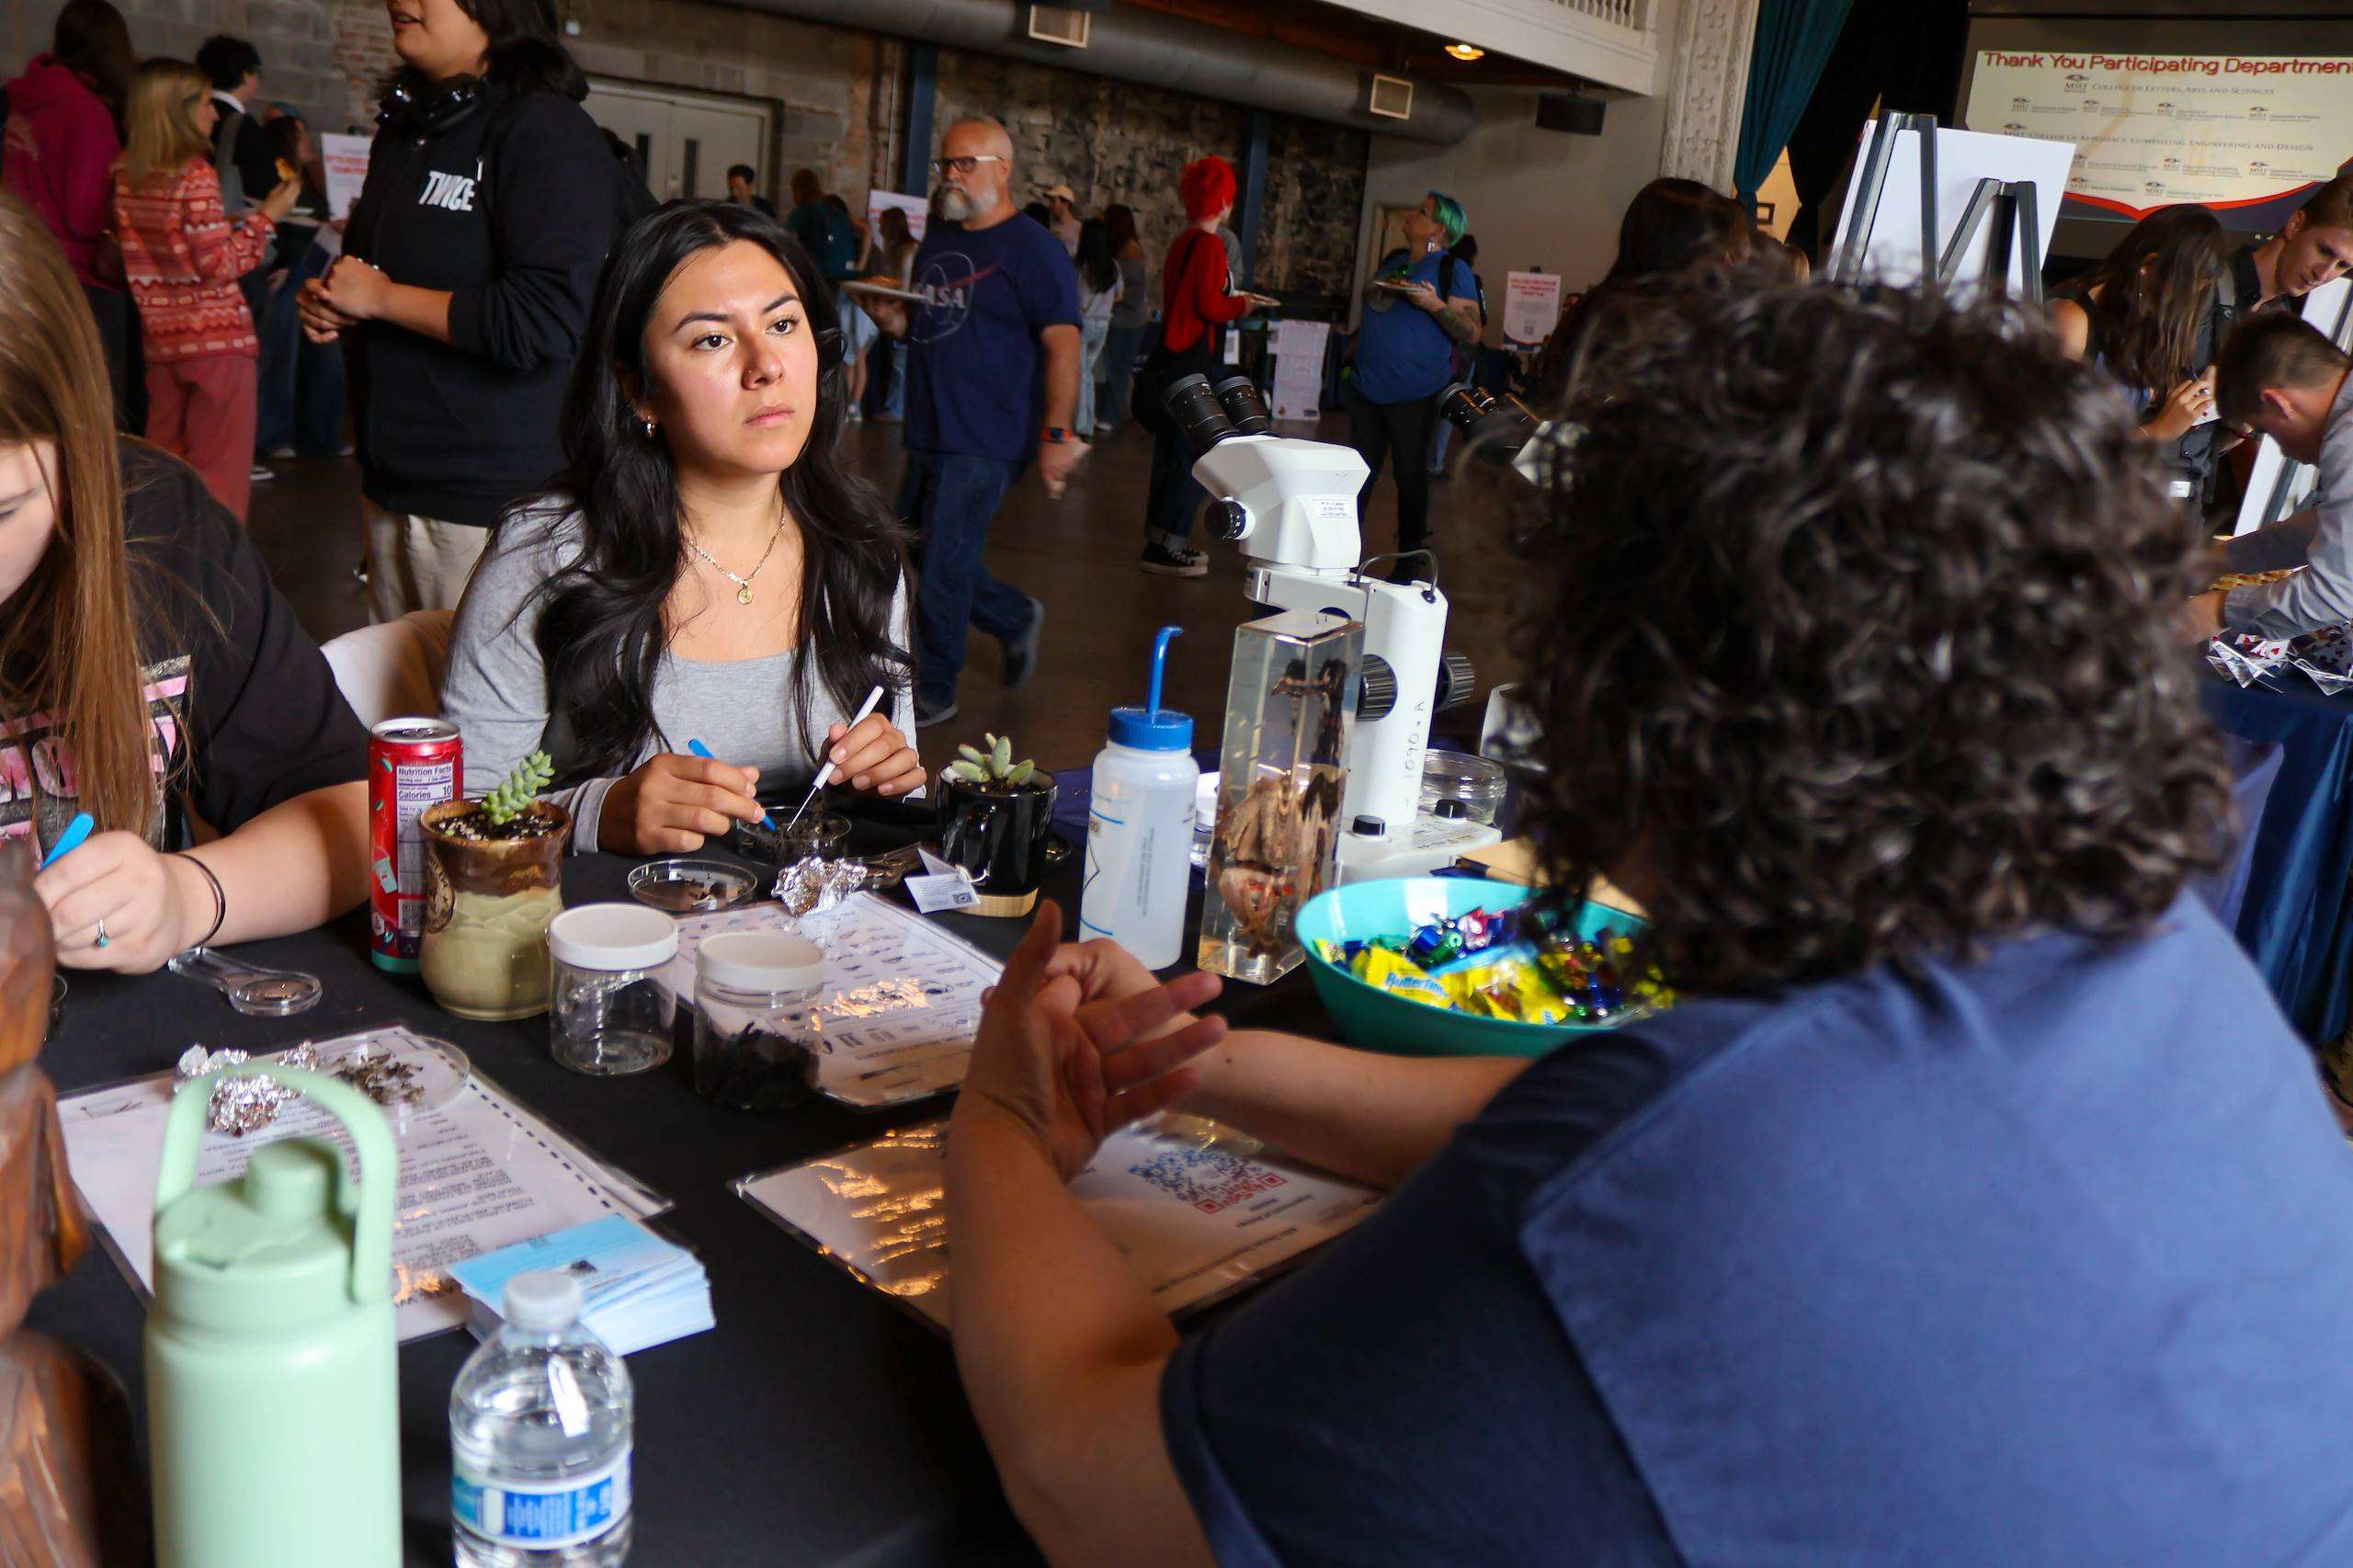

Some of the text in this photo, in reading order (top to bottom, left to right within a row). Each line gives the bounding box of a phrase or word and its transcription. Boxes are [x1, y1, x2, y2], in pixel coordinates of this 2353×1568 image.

[1985, 52, 2353, 75] Thank You Participating Departmen
[418, 170, 475, 211] TWICE
[398, 765, 452, 776] Nutrition Facts
[398, 785, 452, 800] Calories 10
